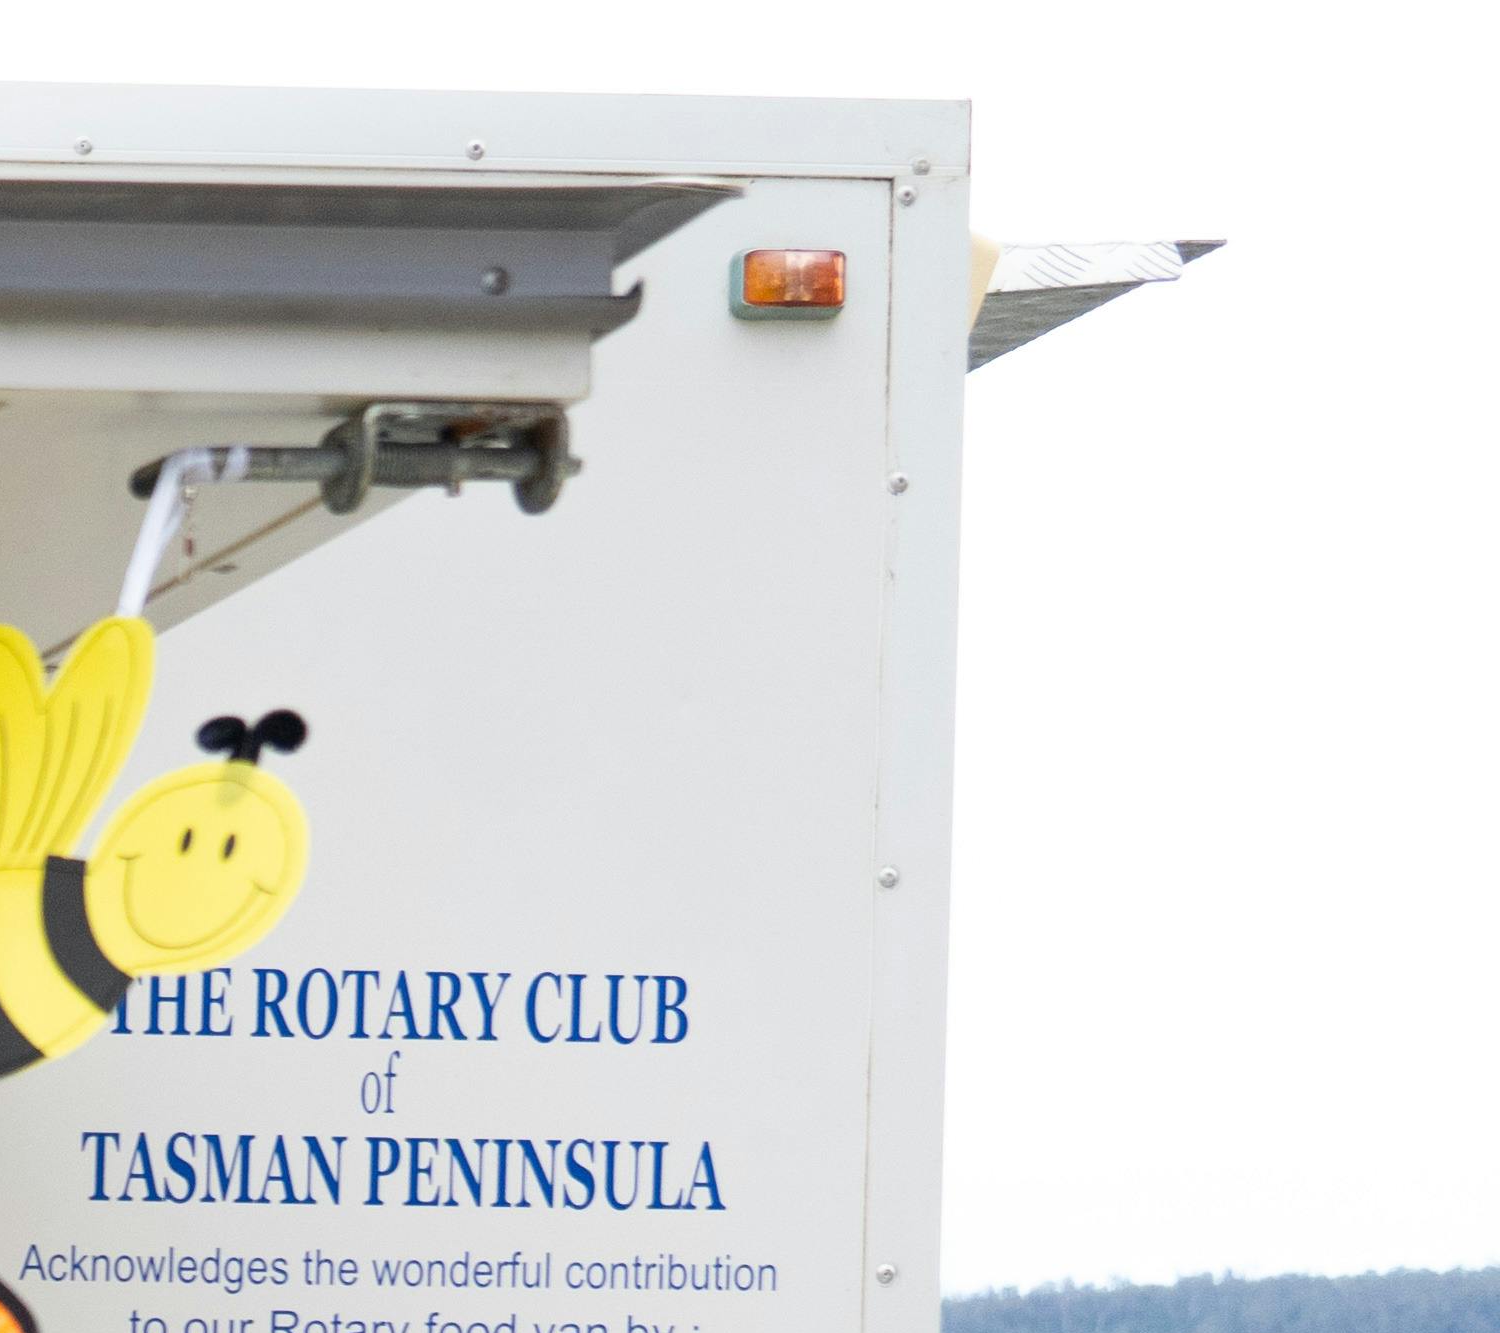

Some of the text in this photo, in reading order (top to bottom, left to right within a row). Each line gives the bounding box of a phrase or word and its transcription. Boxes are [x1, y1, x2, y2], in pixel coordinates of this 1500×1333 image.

[109, 969, 691, 1045] THE ROTARY CLUB
[359, 1051, 400, 1114] of
[81, 1131, 727, 1211] TASMAN PENINSULA
[19, 1244, 778, 1295] Acknowledges the wonderful contribution
